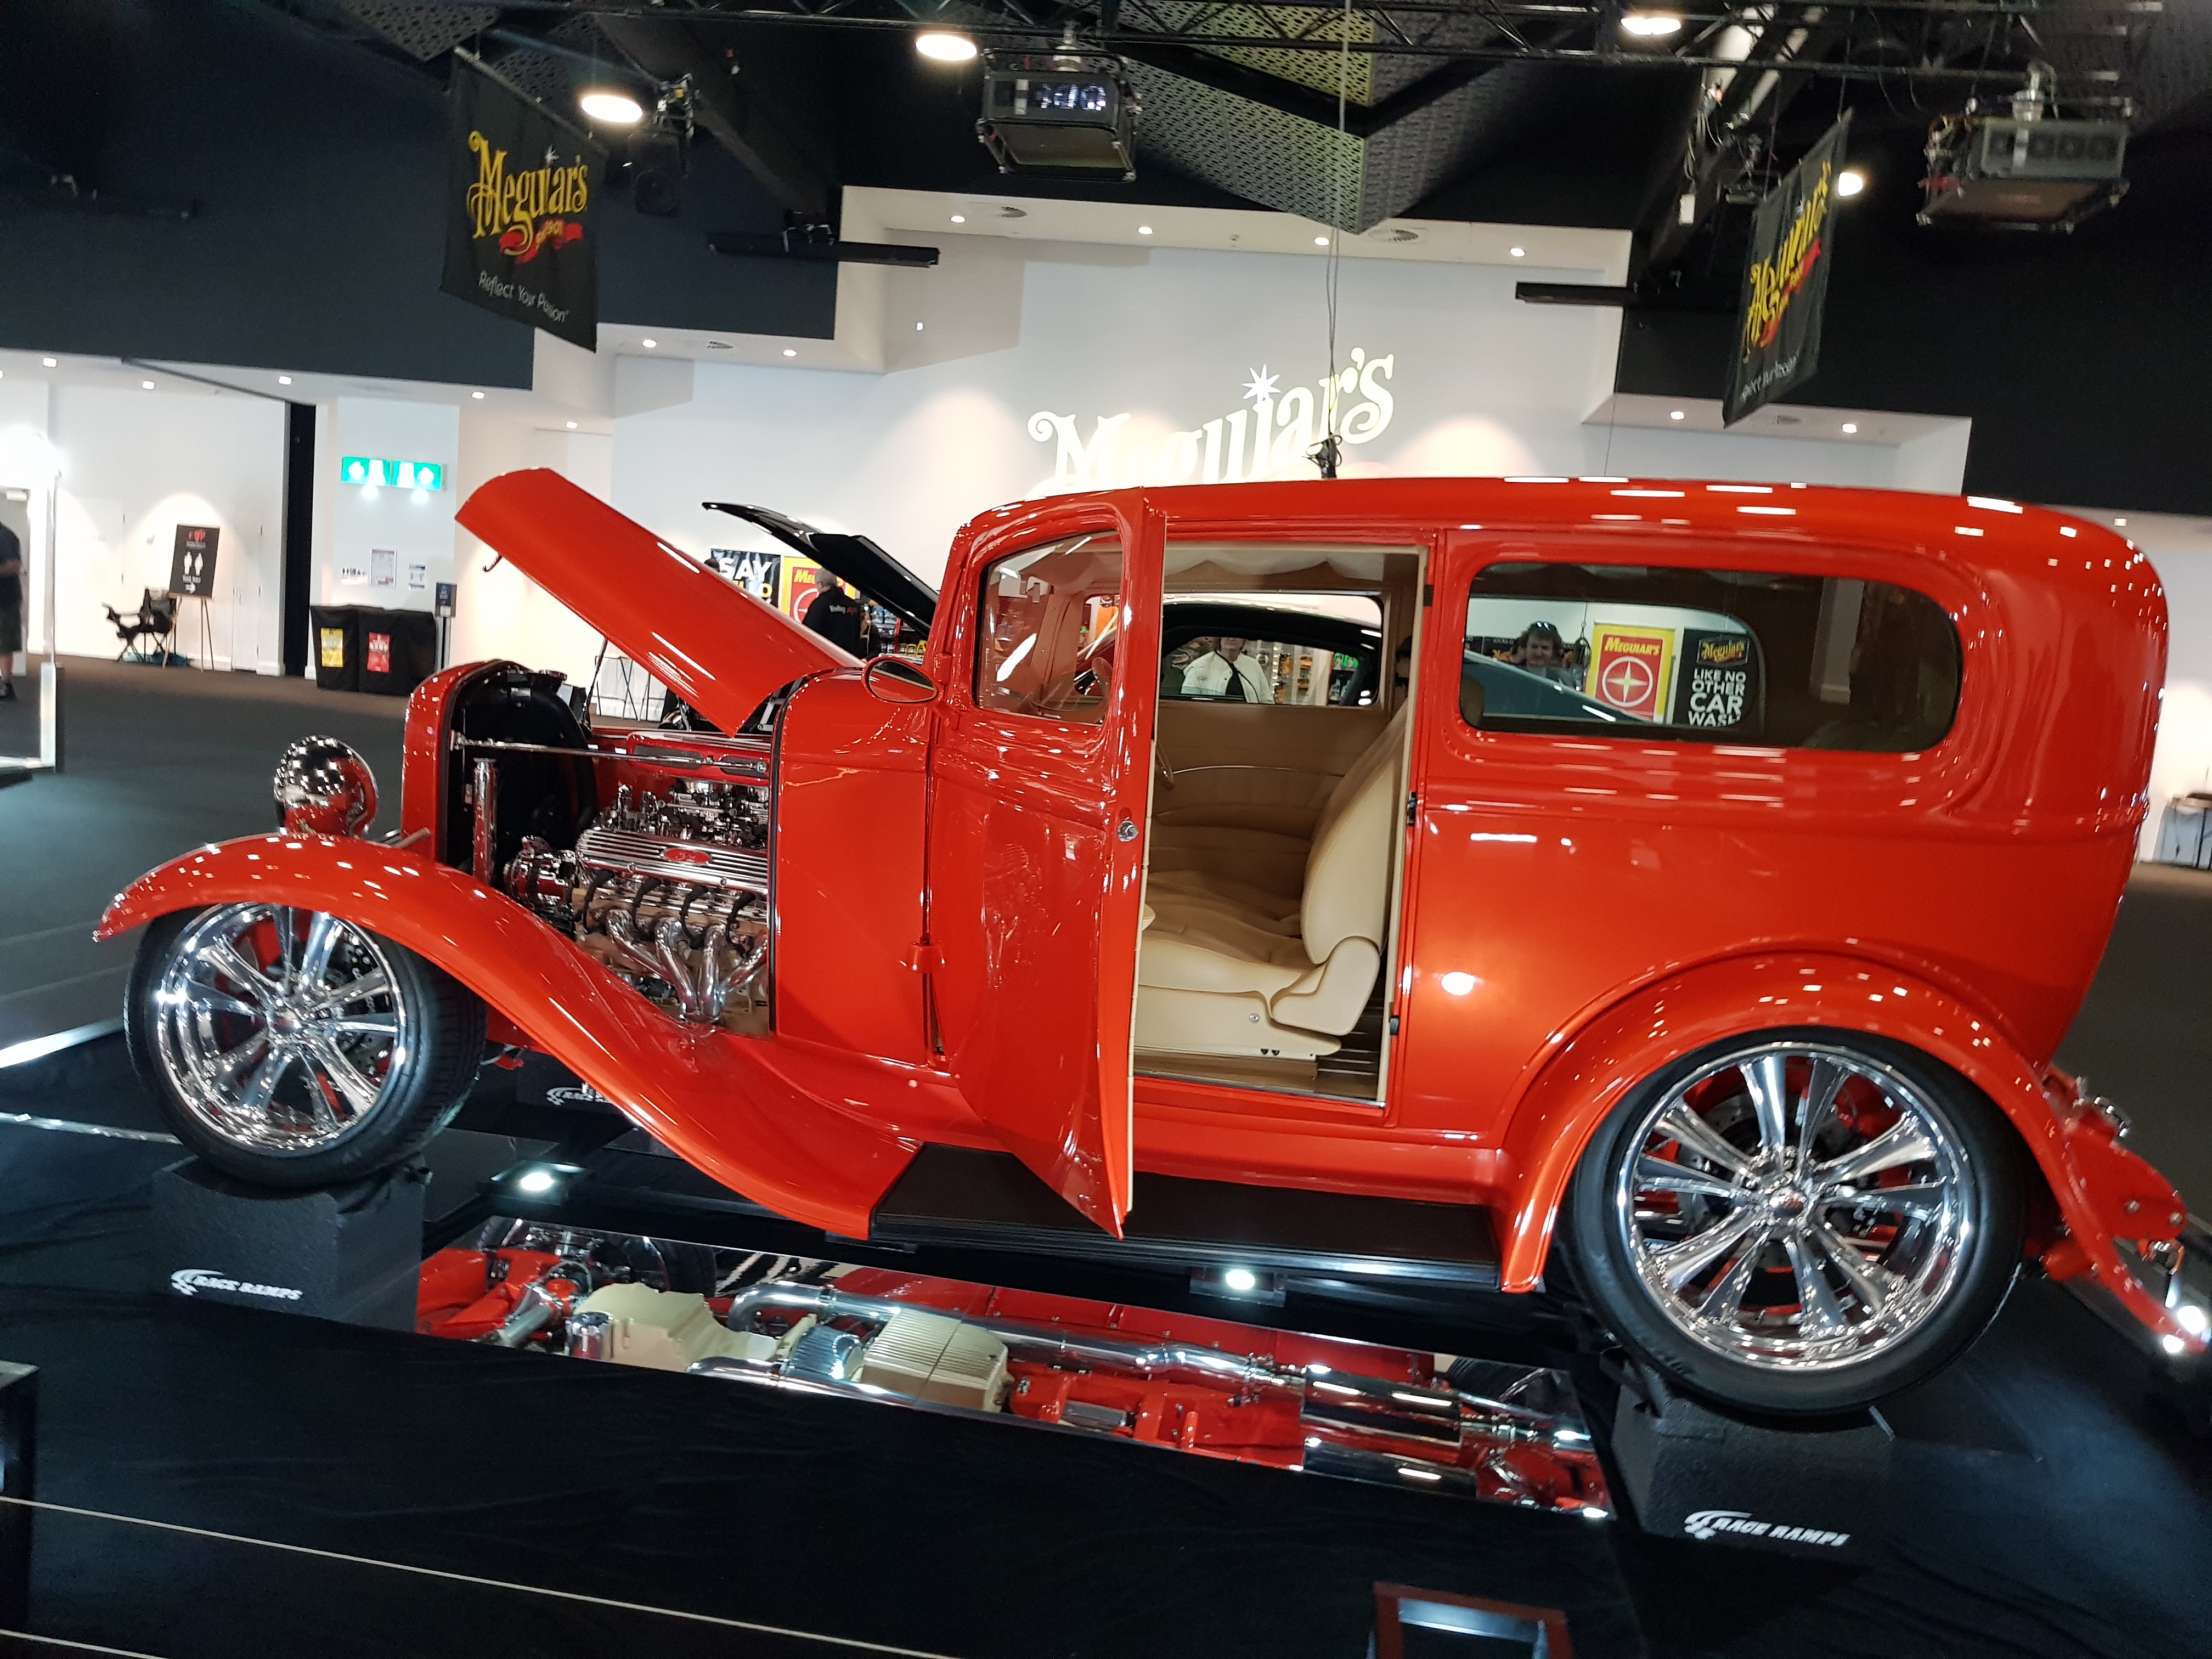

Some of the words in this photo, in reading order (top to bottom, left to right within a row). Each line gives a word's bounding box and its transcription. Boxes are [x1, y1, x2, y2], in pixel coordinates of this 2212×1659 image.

[1026, 347, 1394, 496] Mguiar's
[719, 557, 772, 582] SAY
[1694, 668, 1722, 681] LIKE
[1725, 671, 1746, 684] NO
[1692, 680, 1746, 696] OTHER
[1690, 692, 1743, 715] CAR
